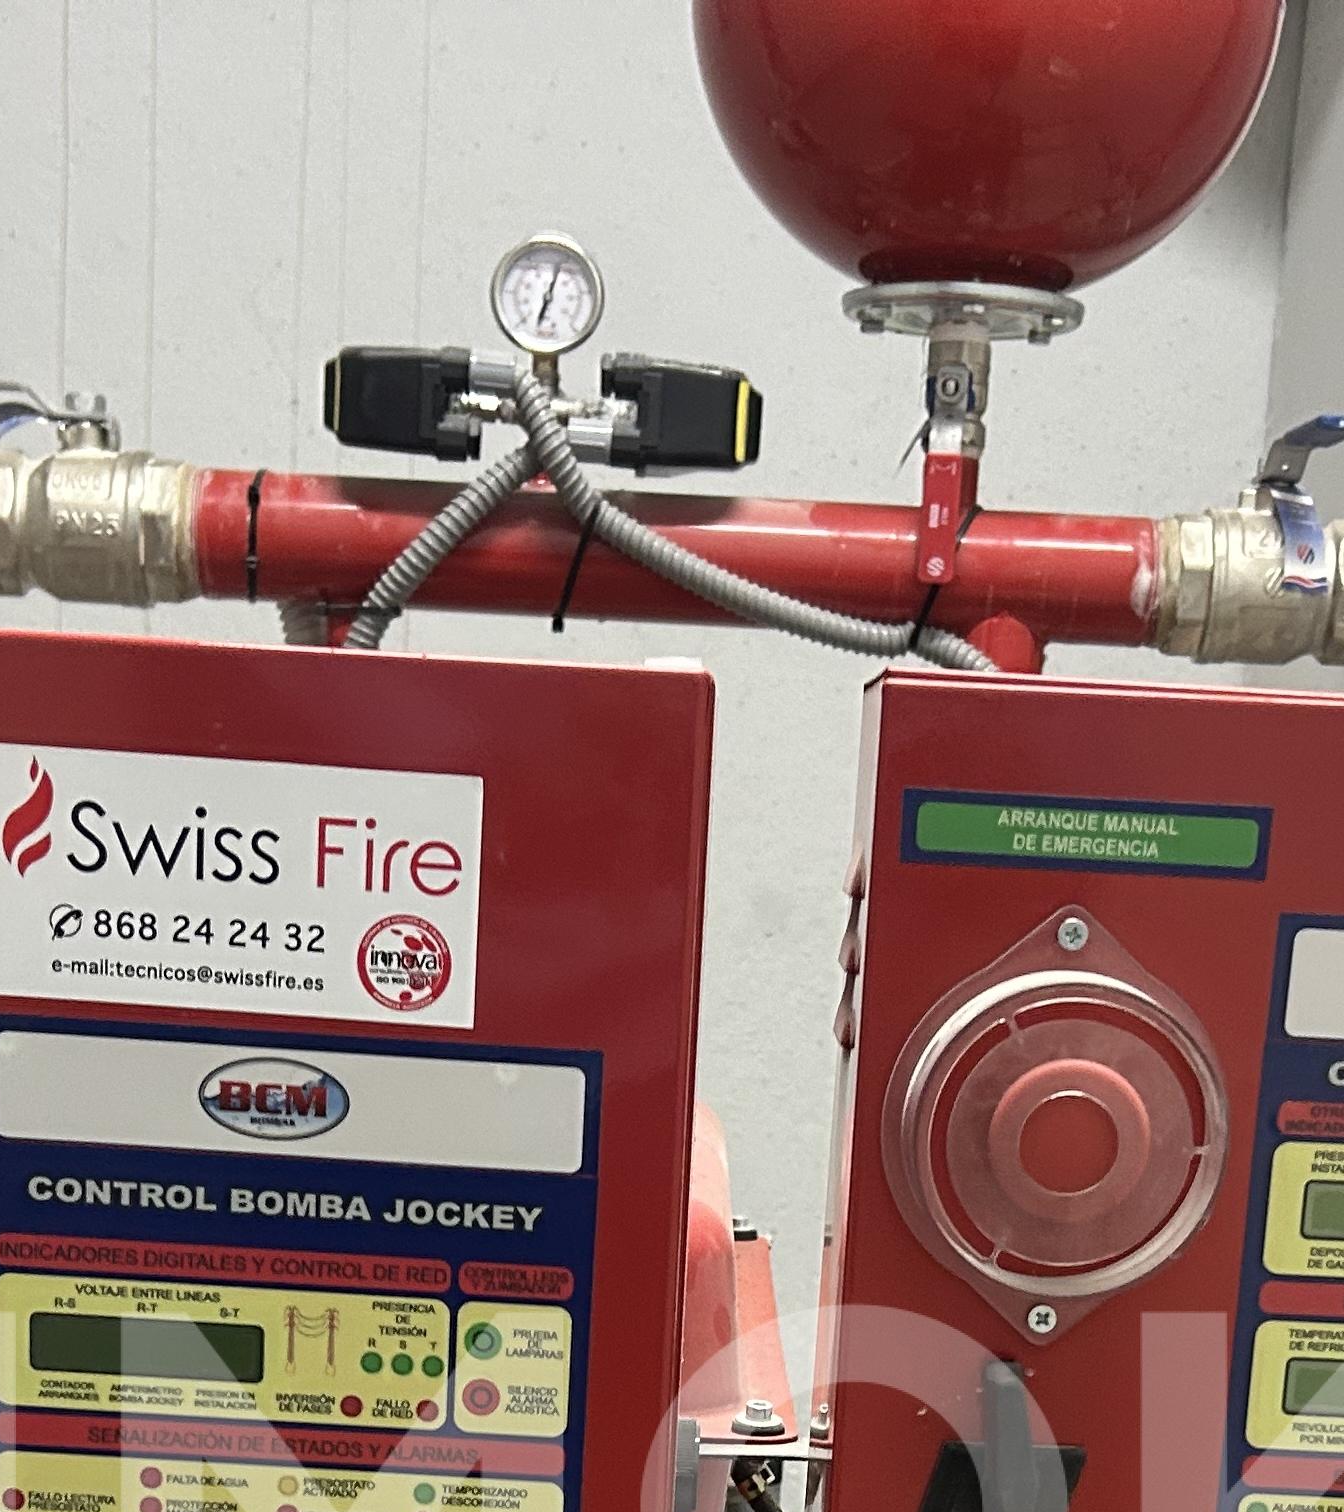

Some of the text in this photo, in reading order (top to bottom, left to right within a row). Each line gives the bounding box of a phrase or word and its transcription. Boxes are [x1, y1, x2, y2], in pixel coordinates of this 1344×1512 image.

[998, 808, 1180, 836] ARRANQUE MANUAL
[66, 800, 463, 897] Swiss Fire
[1013, 833, 1159, 858] DE EMERGENCIA
[93, 909, 326, 954] 868 24 24 32
[219, 1079, 327, 1118] BCM
[28, 1174, 542, 1233] CONTROL BOMBA JOCKEY
[0, 1240, 447, 1284] INDICADORES DIGITALES Y CONTROL DE RED
[1307, 1260, 1323, 1269] DE
[76, 1283, 128, 1299] VOLTAJE
[132, 1287, 173, 1301] ENTRE
[137, 1302, 158, 1313] R-T
[372, 1301, 436, 1314] PRESENCIA
[396, 1314, 410, 1324] DE
[88, 1427, 479, 1465] SEÑALIZACIÓN DE ESTADOS Y ALARMAS
[1299, 1434, 1324, 1444] POR
